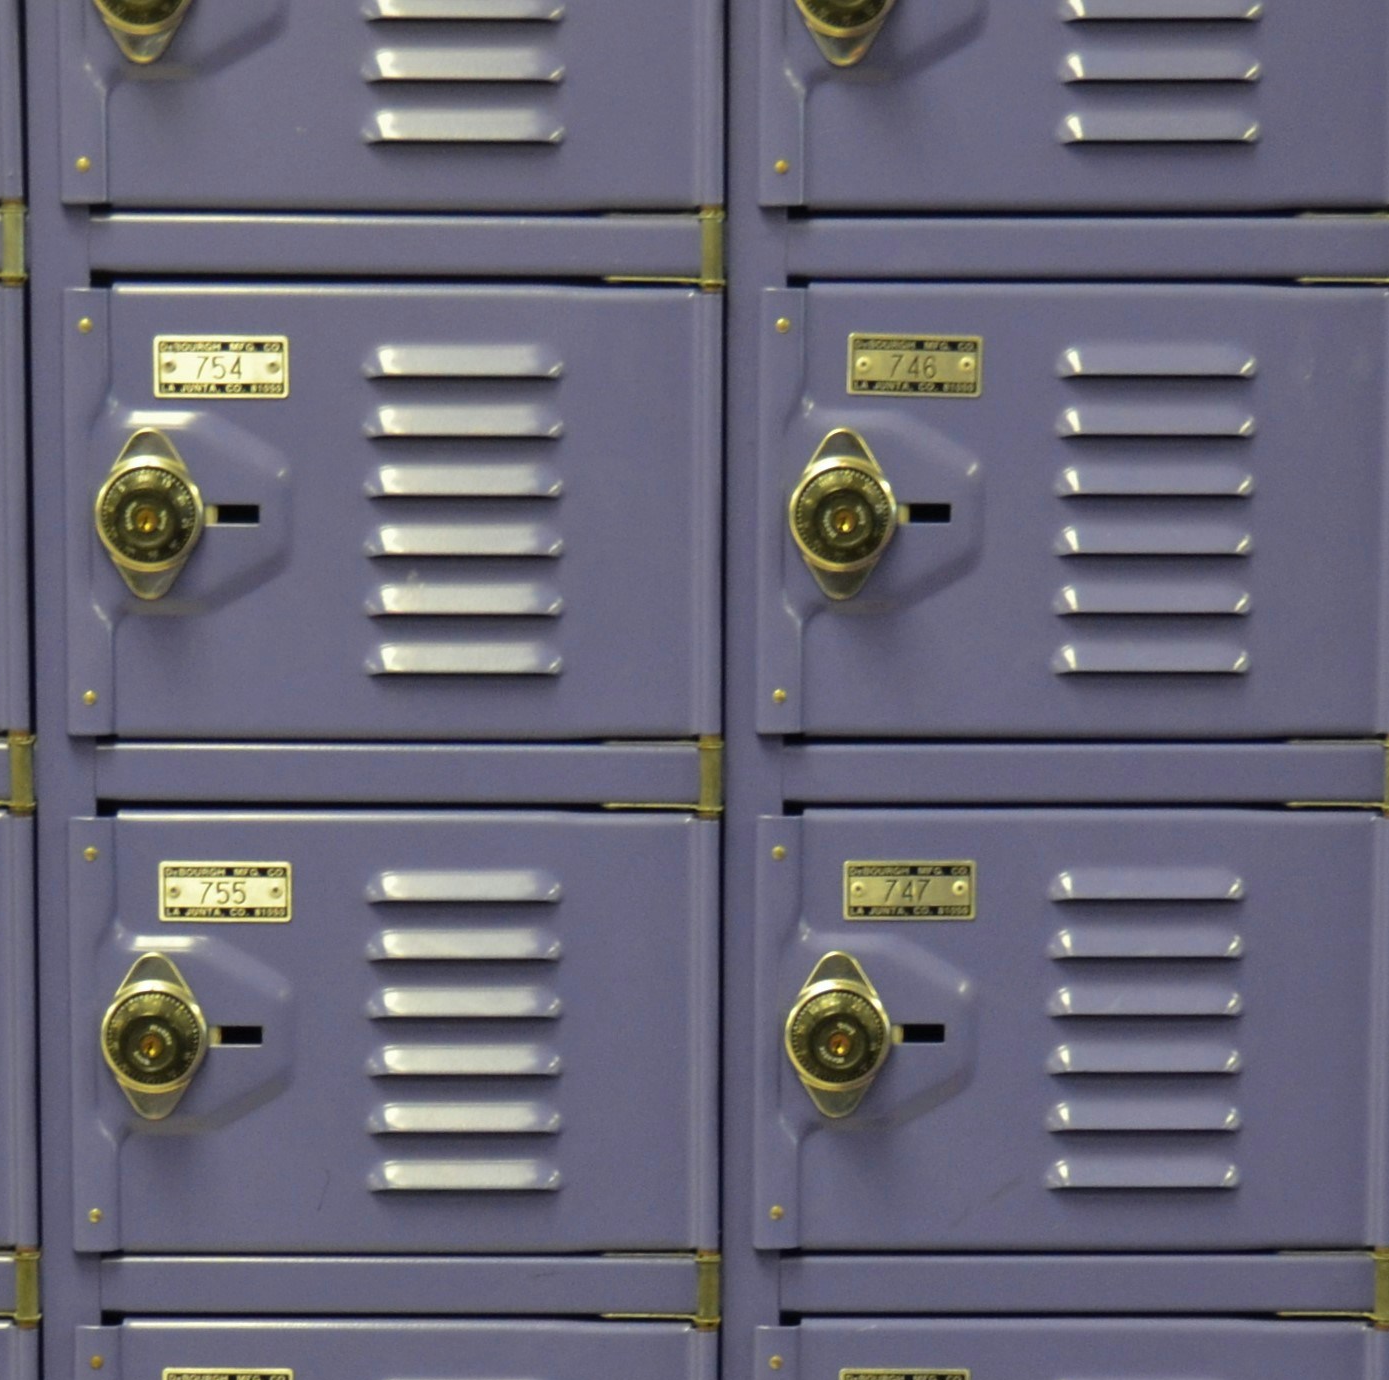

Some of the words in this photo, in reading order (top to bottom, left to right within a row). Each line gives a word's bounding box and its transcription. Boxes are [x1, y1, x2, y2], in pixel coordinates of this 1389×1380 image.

[195, 355, 243, 380] 754
[889, 353, 937, 379] 746
[161, 384, 175, 392] LA
[200, 880, 247, 904] 755
[884, 879, 931, 903] 747
[166, 908, 180, 916] LA
